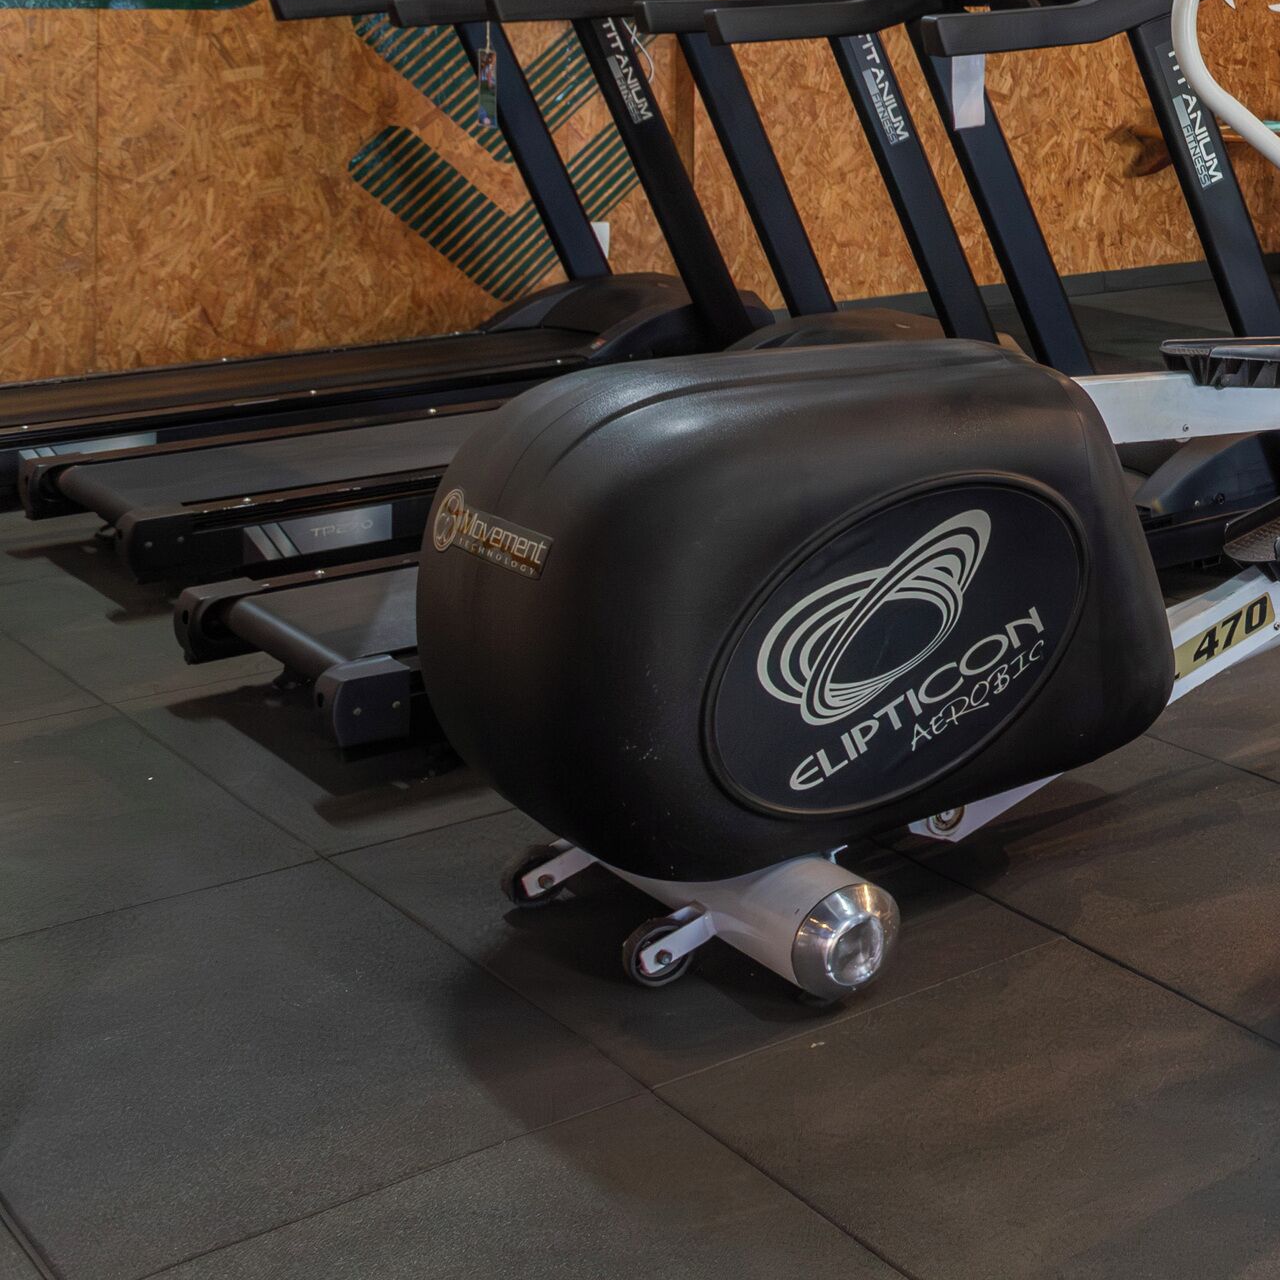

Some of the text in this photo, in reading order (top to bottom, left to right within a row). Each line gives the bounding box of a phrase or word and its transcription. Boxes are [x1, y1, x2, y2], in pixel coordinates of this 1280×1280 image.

[602, 17, 654, 122] TITANIUM
[857, 33, 910, 142] TITANIUM
[871, 92, 898, 145] FITNESS
[1182, 123, 1212, 190] FITNESS
[459, 536, 537, 576] TECHNOLOGY
[460, 508, 547, 564] Movement
[1193, 595, 1268, 663] 470
[789, 606, 1045, 791] ELIPTICON
[911, 639, 1045, 753] AEROBIC
